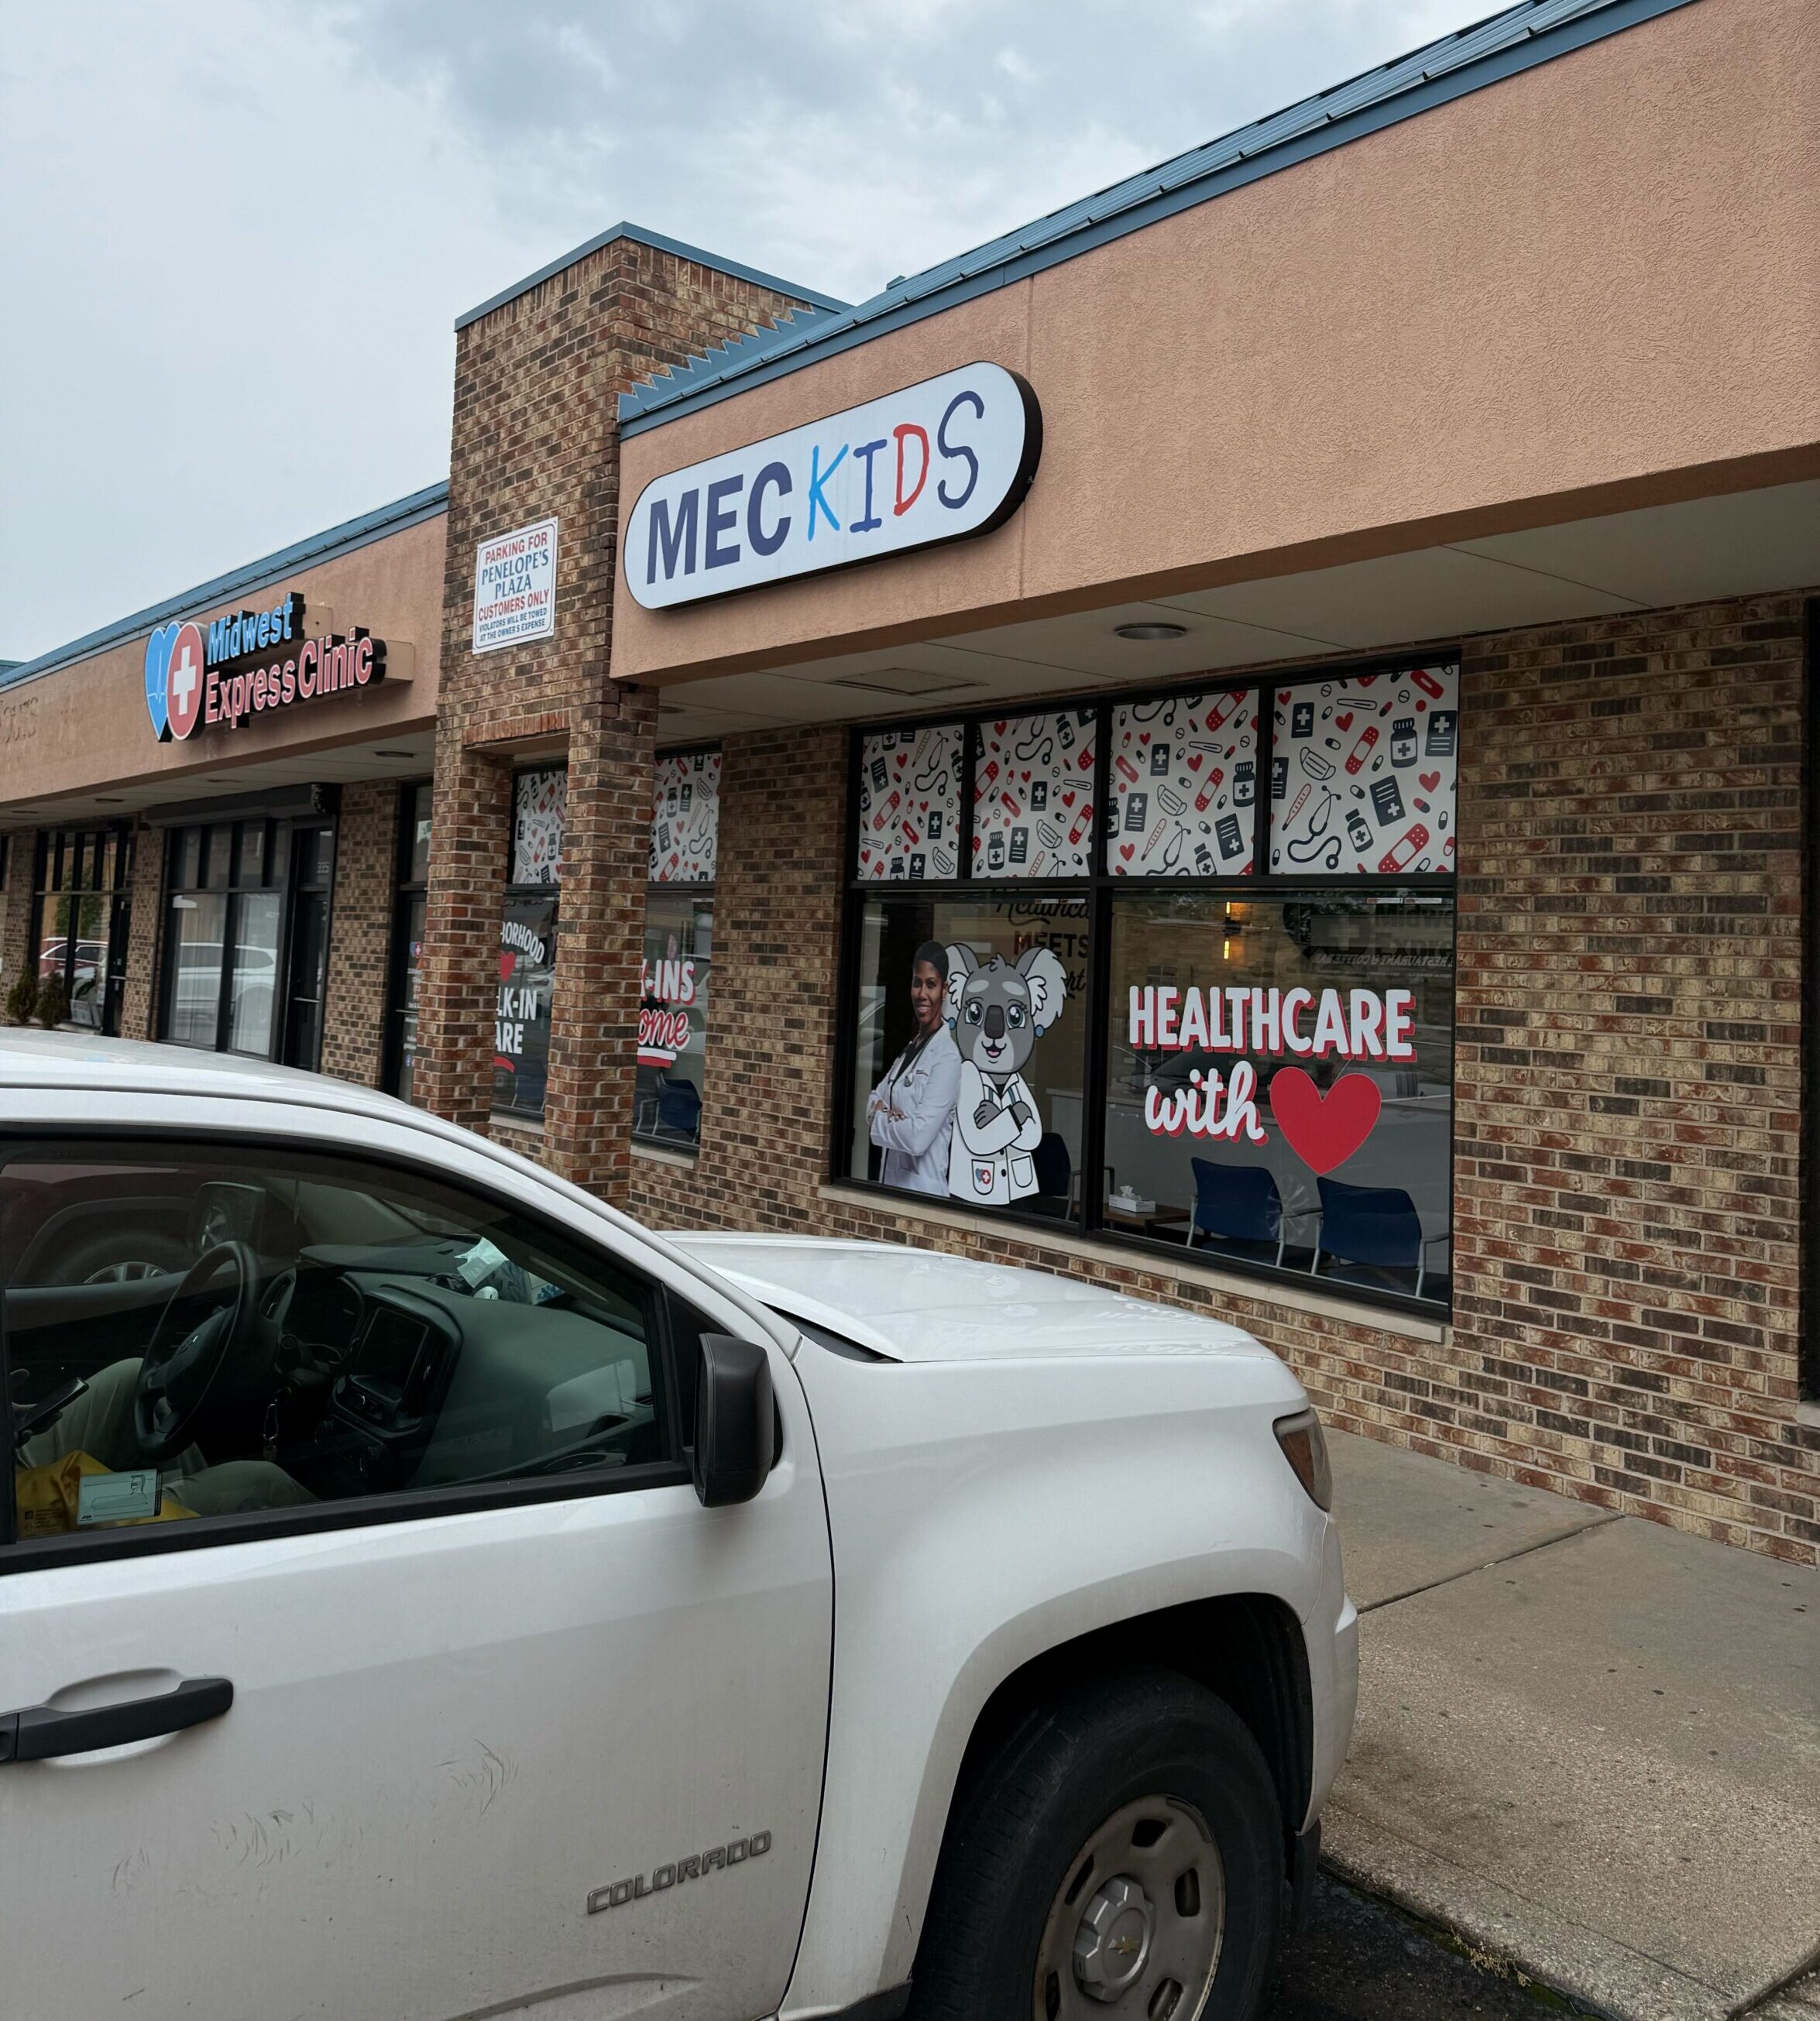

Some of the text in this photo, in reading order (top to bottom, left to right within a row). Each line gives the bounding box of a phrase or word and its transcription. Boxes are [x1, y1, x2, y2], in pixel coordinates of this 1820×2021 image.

[646, 390, 985, 585] MEC KIDS
[482, 548, 548, 585] PENELOPE'S
[485, 532, 547, 564] PARKING FOR
[479, 588, 549, 621] CUSTOMERS ONLY
[494, 574, 531, 599] PLAZA
[207, 592, 294, 666] Midwest
[479, 607, 547, 631] VIOLATORS WILL BE TOWED
[479, 633, 486, 641] AT
[486, 630, 496, 639] THE
[521, 618, 544, 630] EXPENSE
[495, 1021, 524, 1055] ARE
[637, 1008, 691, 1052] ome
[1128, 985, 1418, 1063] HEALTHCARE
[1145, 1060, 1269, 1146] with
[586, 1829, 773, 1915] COLORADO
